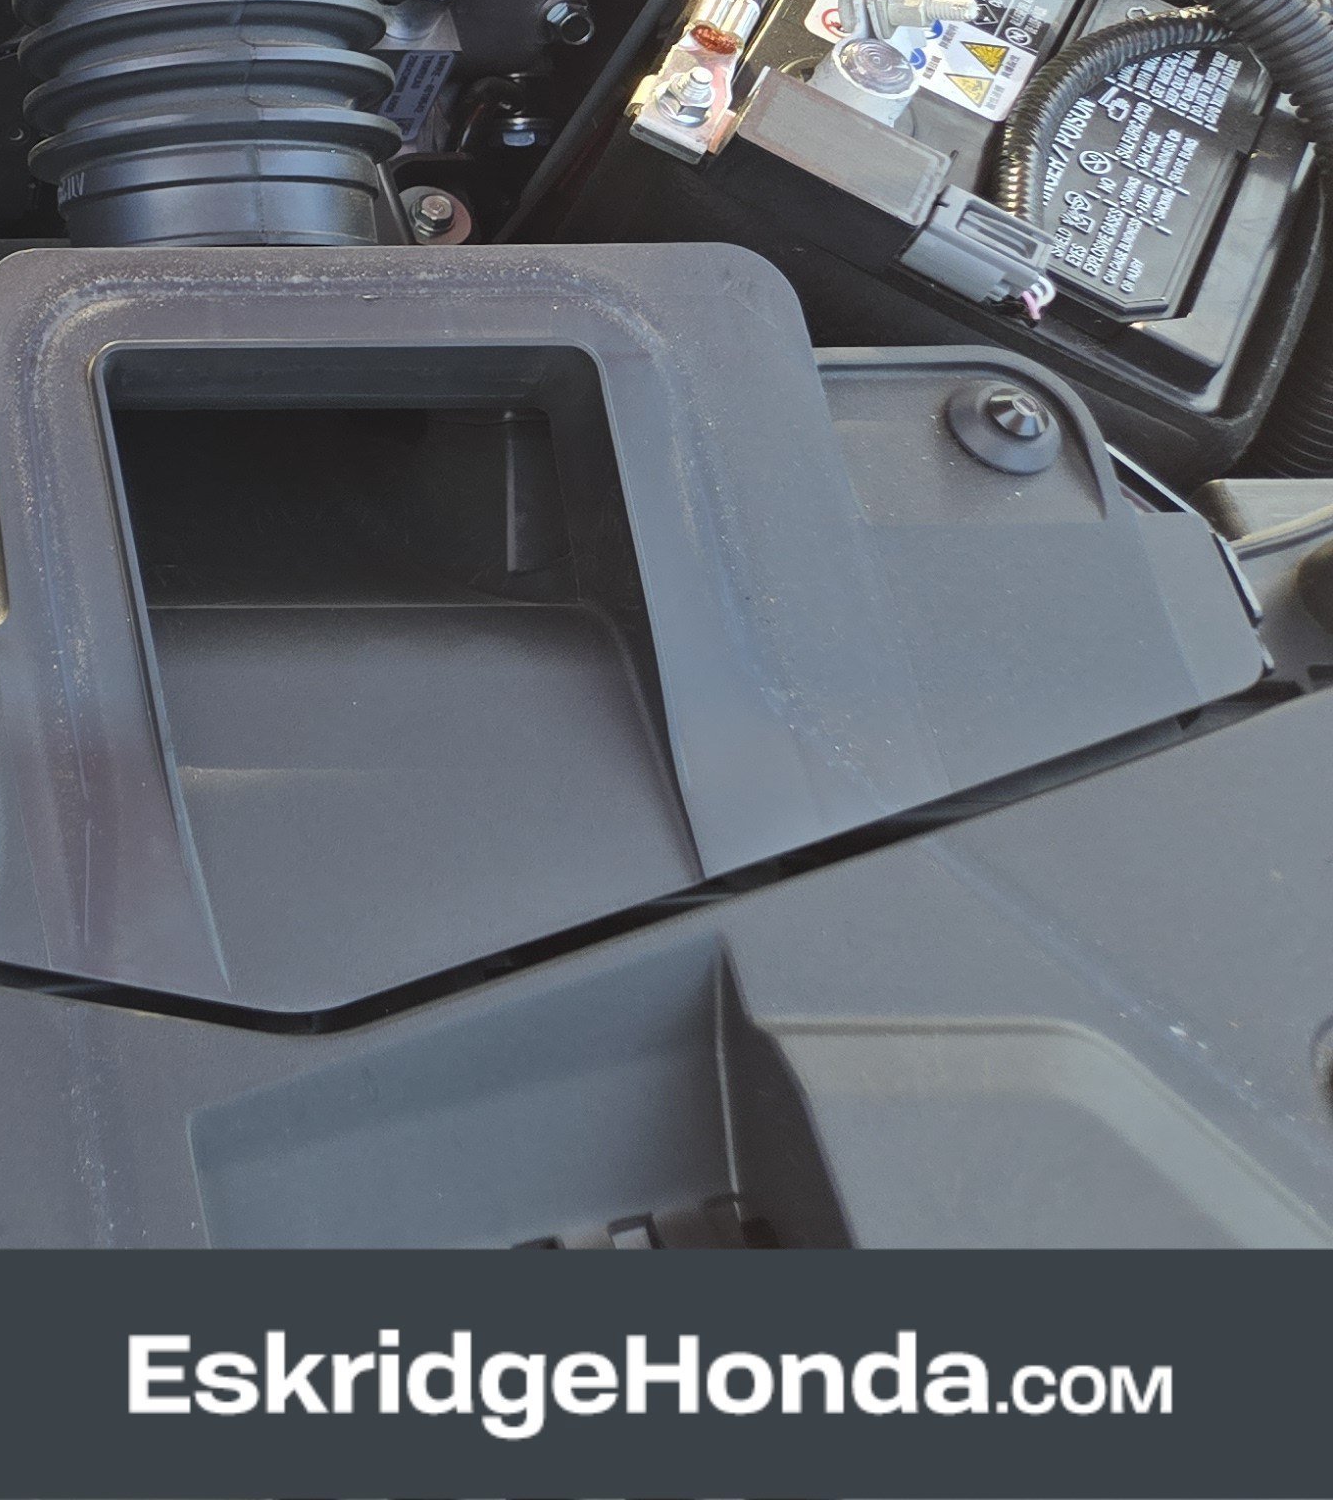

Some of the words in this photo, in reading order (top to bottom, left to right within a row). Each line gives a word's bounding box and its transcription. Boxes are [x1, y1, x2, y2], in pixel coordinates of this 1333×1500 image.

[1115, 120, 1144, 159] SULFURIC
[1133, 102, 1153, 124] ACID
[1142, 132, 1161, 153] CAUSE
[1135, 152, 1152, 167] CAN
[1098, 178, 1117, 193] NO
[1120, 176, 1141, 202] SPARKS
[1136, 184, 1158, 211] FLAMES
[1153, 188, 1176, 219] SMOKING
[1047, 228, 1073, 257] SHIELD
[1084, 233, 1113, 275] EXPLOSIVE
[1101, 208, 1125, 235] GASES
[1066, 243, 1088, 266] EYES
[1109, 249, 1128, 271] CAUSE
[1103, 269, 1120, 284] CAN
